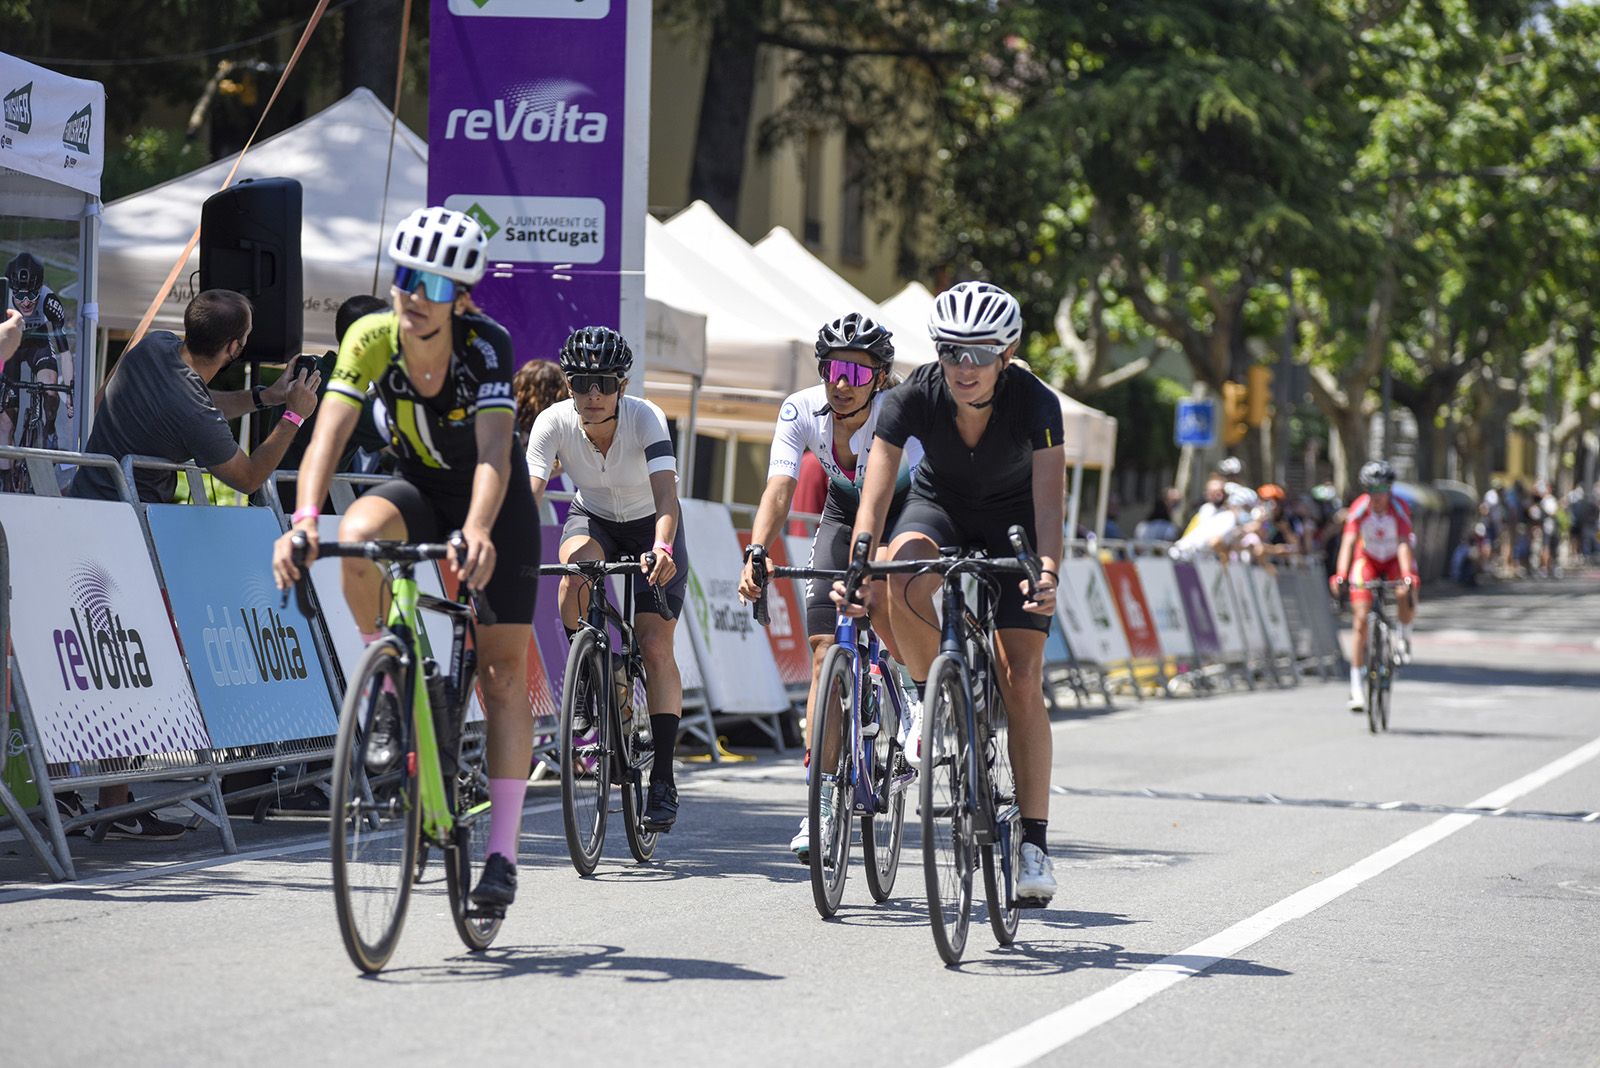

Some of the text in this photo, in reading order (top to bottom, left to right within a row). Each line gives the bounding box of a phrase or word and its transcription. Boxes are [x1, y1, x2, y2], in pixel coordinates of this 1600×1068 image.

[445, 99, 608, 143] reVolta
[505, 216, 598, 228] AJUNTAMENT DE
[505, 226, 599, 247] SantCugat
[477, 382, 510, 397] BH
[53, 606, 153, 691] reVolta
[202, 603, 308, 688] cicloVolta
